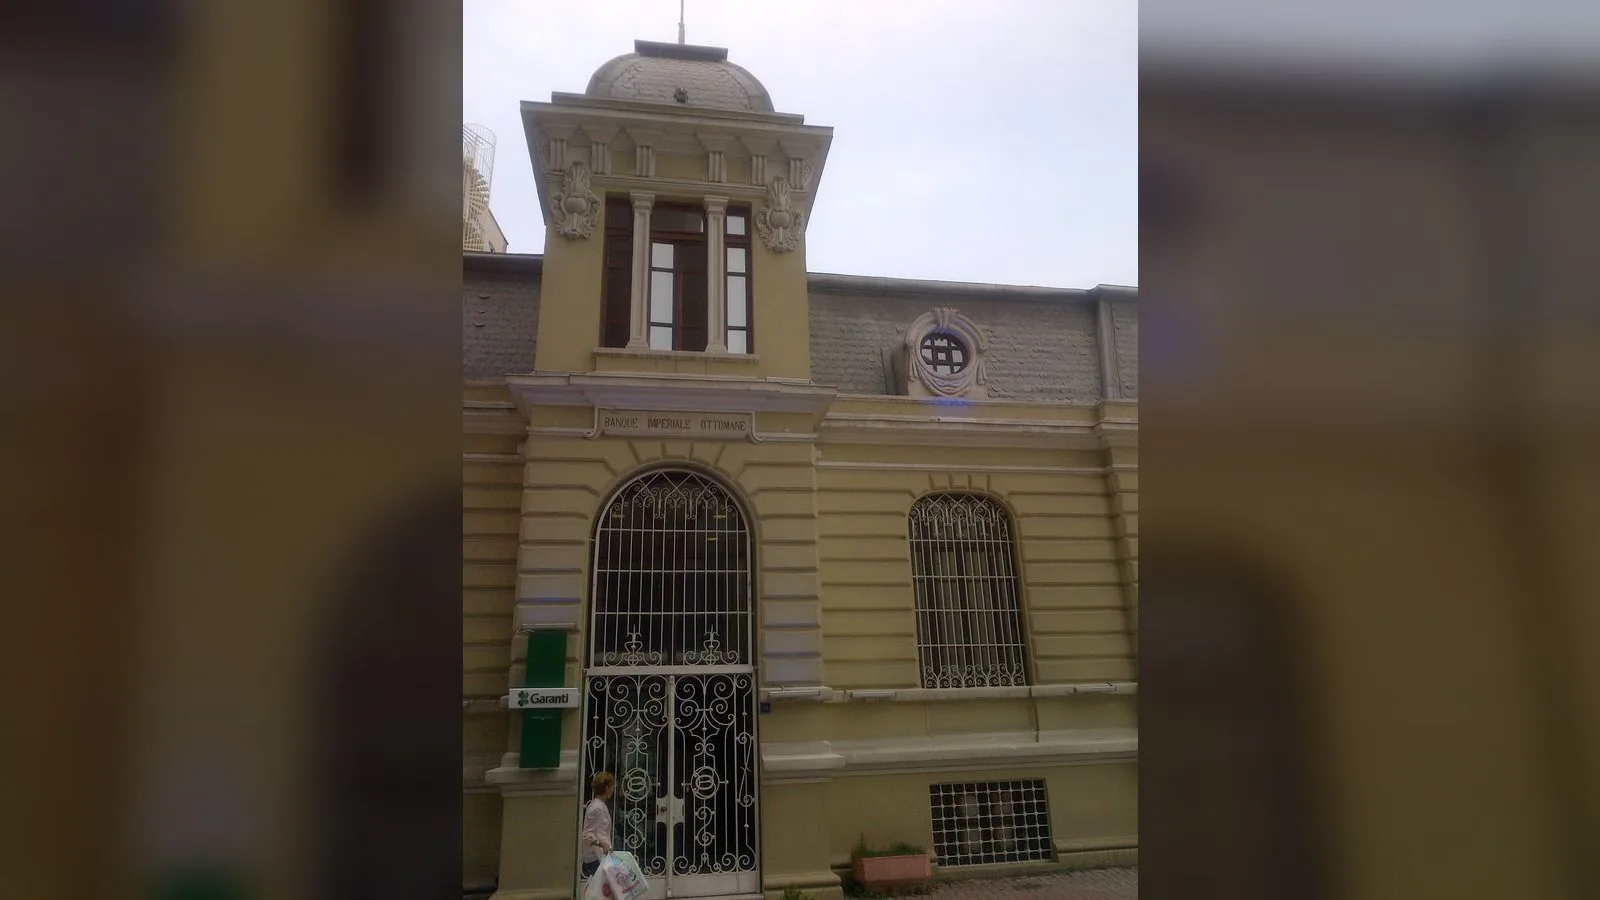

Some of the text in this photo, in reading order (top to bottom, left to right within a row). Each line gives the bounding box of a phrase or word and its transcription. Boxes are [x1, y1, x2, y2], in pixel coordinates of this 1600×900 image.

[604, 416, 746, 432] BANQUE IMPERIALE OTTOMANE
[530, 692, 569, 704] Garanti
